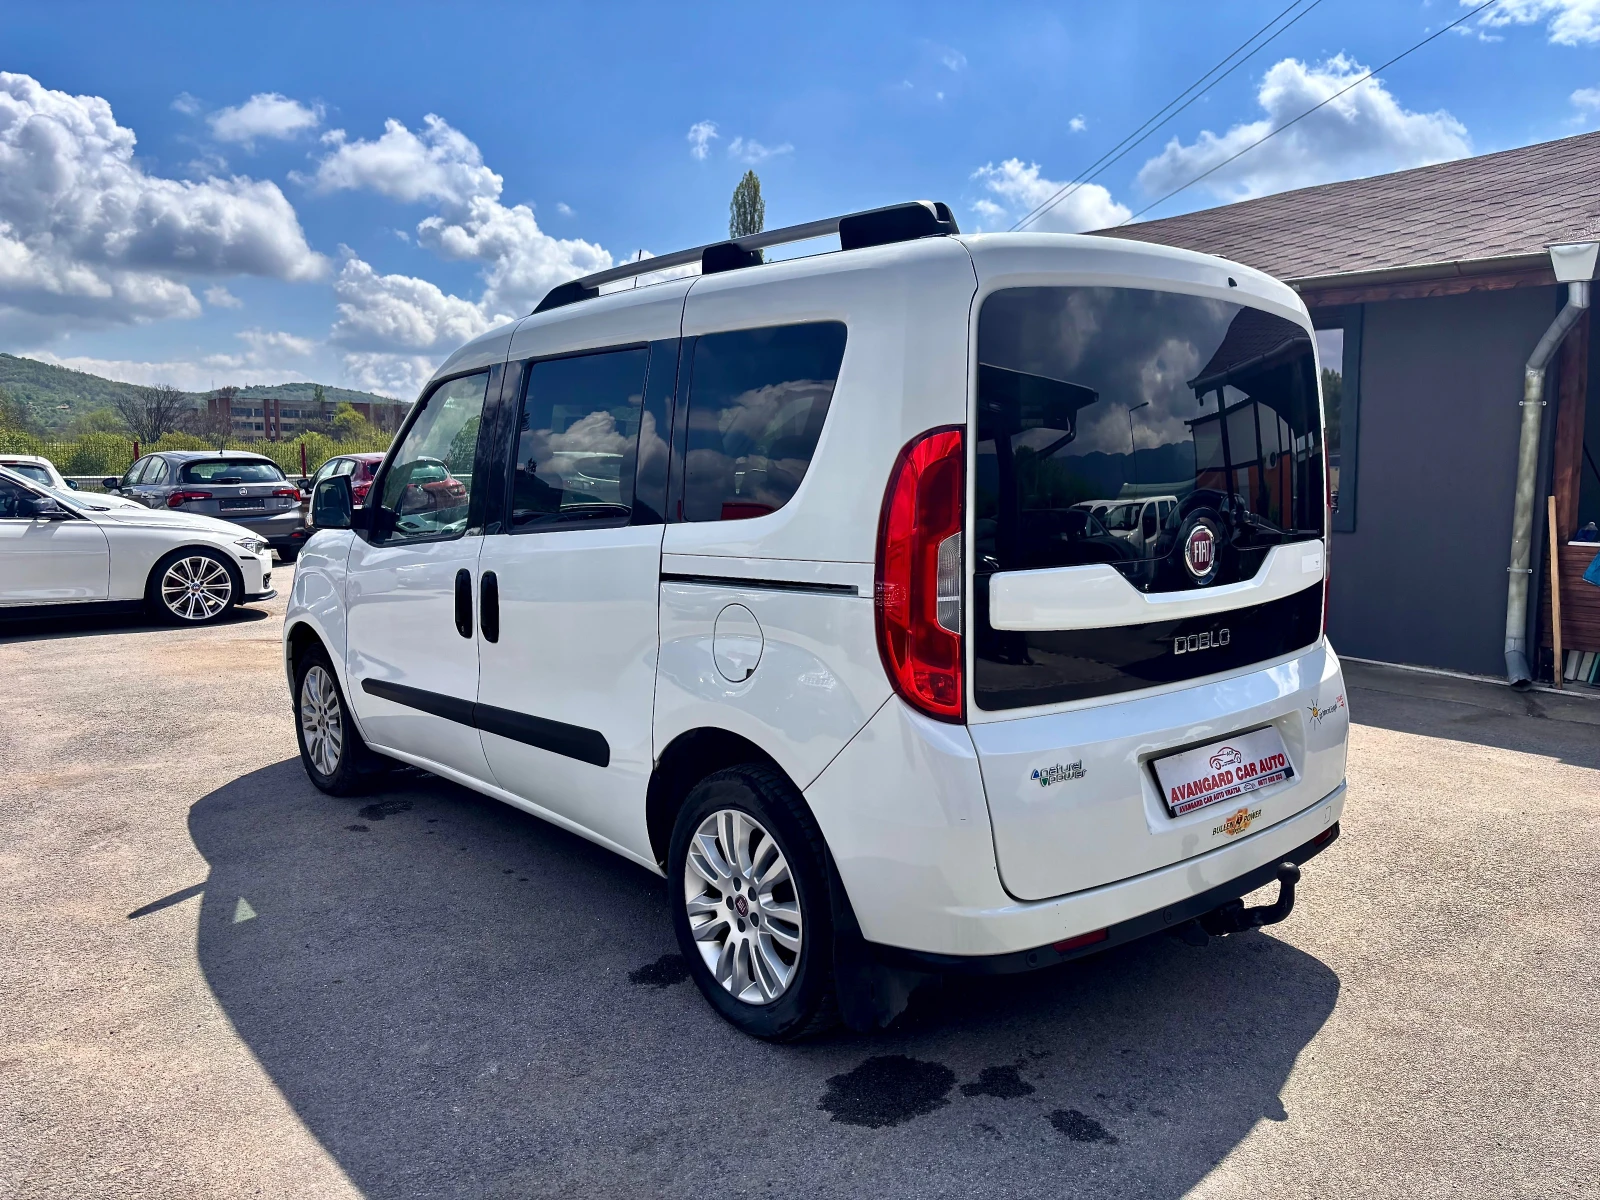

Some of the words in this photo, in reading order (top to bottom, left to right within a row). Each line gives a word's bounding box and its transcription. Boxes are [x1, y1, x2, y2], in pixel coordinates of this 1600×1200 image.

[1193, 540, 1211, 562] FIAT
[1174, 628, 1230, 655] DOBLO
[1040, 759, 1082, 775] natural
[1048, 769, 1087, 786] power
[1171, 770, 1234, 803] AVANGARD
[1235, 766, 1258, 781] CAR
[1259, 753, 1285, 773] AUTO
[1179, 800, 1203, 814] AVANGARD
[1213, 792, 1225, 800] AUTO
[1243, 809, 1262, 822] POWER
